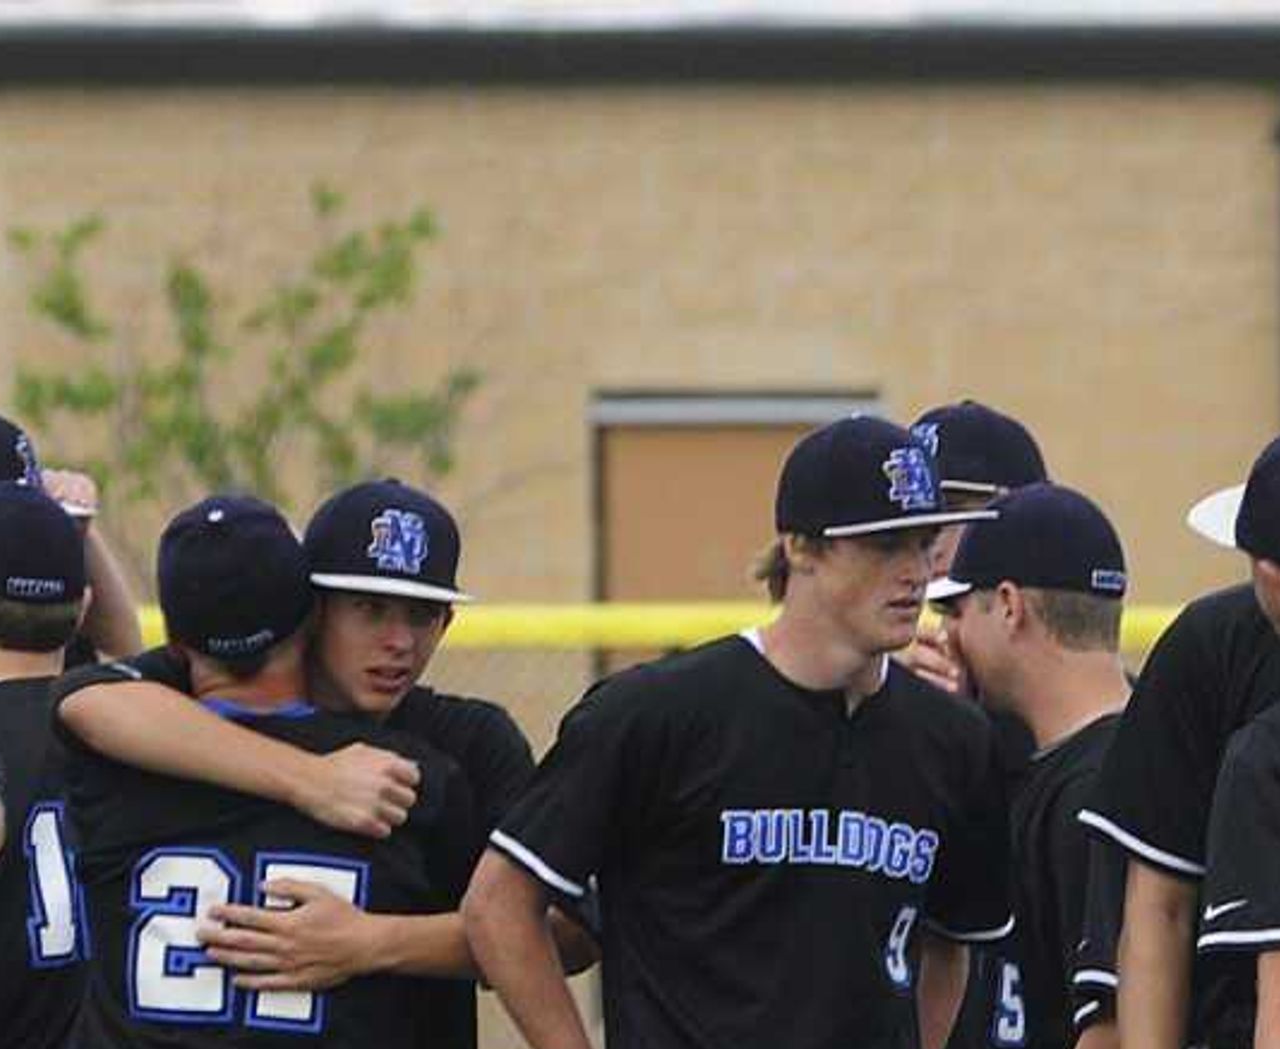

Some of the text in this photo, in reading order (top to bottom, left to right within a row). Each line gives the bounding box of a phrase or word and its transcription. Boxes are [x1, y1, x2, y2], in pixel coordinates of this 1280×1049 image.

[722, 808, 938, 883] BULLDOGS
[886, 906, 916, 988] 9
[993, 962, 1025, 1048] 5
